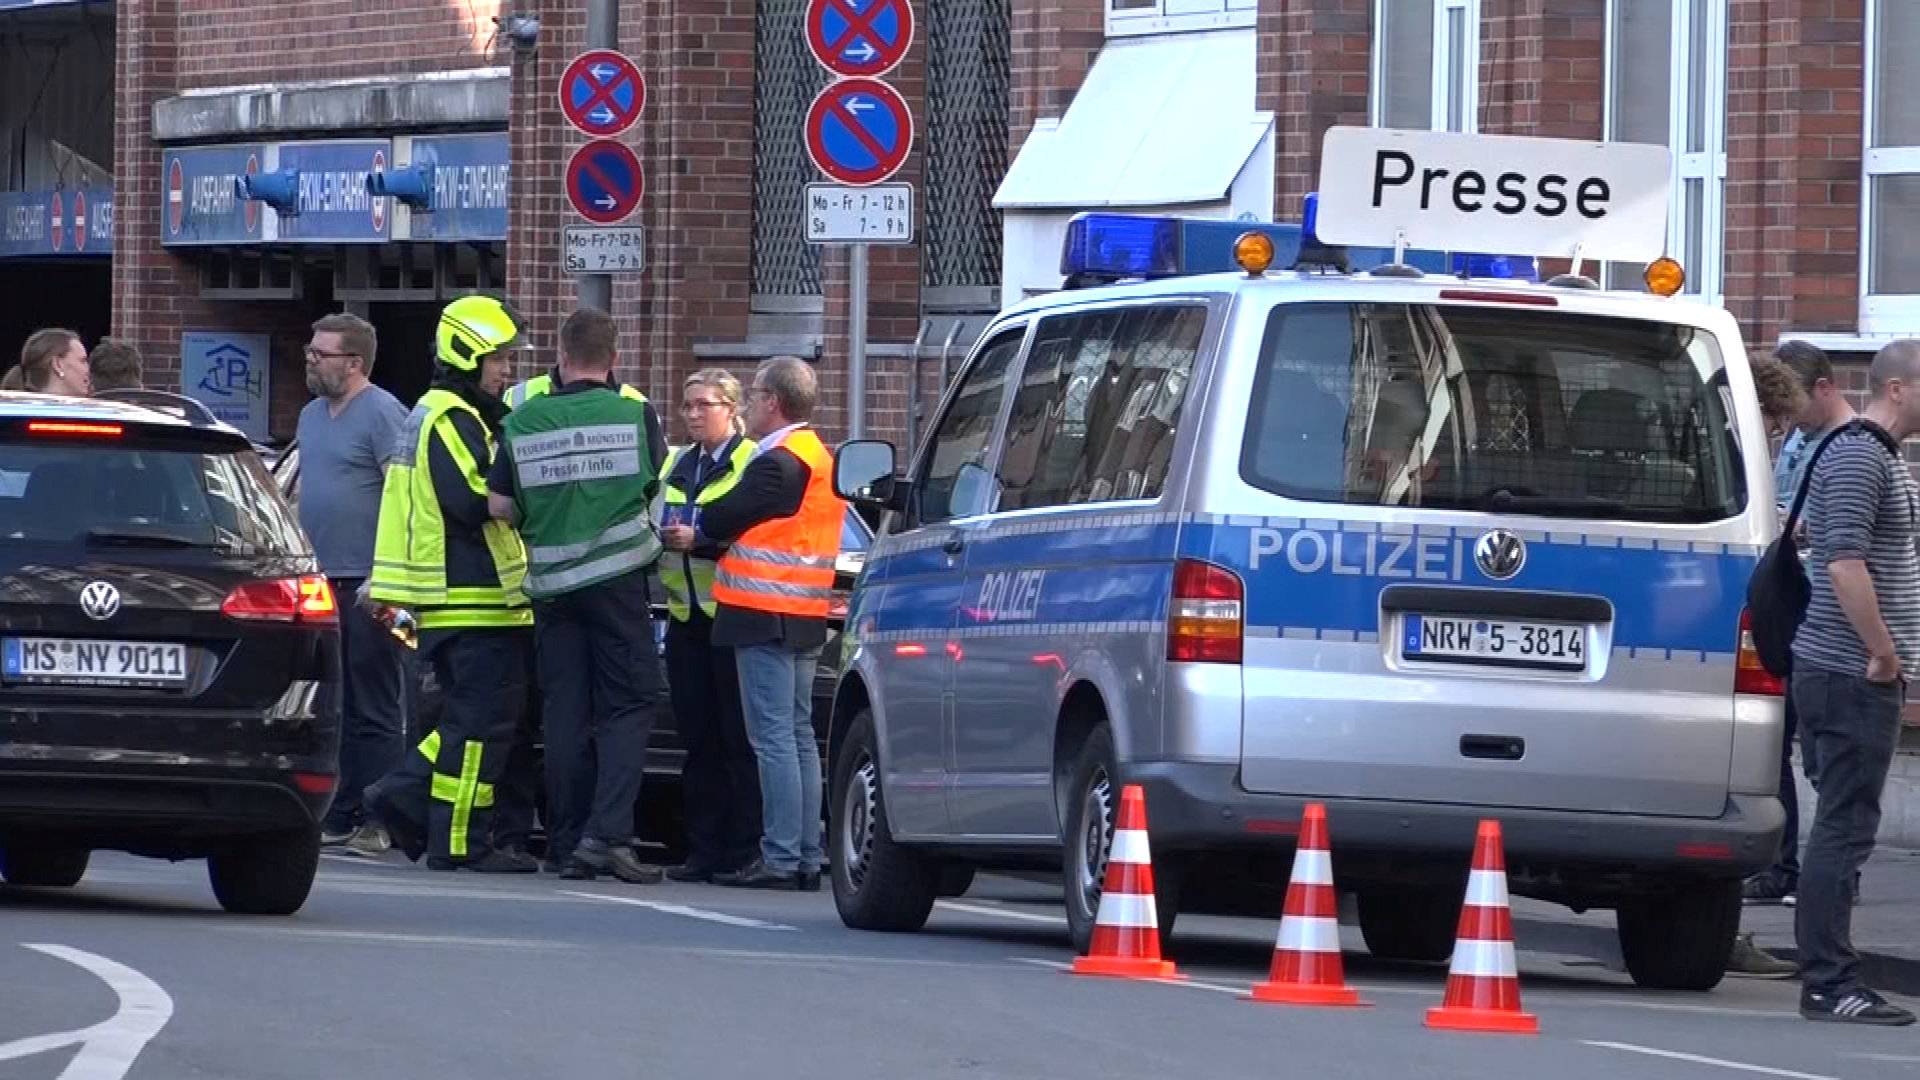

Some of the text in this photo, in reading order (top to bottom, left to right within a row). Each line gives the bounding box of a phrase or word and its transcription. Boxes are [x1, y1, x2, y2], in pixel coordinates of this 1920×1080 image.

[191, 175, 237, 214] AUSFAHRT
[299, 171, 370, 211] PKW-EINFAHRT
[434, 164, 510, 208] PKW-EINFAHR
[813, 194, 828, 210] Mo
[843, 194, 853, 210] Fr
[861, 195, 867, 210] 7
[884, 195, 893, 210] 12
[898, 195, 904, 210] h
[1372, 149, 1611, 219] Presse
[813, 217, 826, 233] Sa
[861, 218, 866, 233] 7
[887, 218, 893, 233] 9
[898, 218, 904, 233] h
[567, 254, 586, 268] Sa
[516, 437, 571, 457] FEUERWEHR
[1249, 527, 1463, 581] POLIZEI
[977, 569, 1046, 622] POLIZEI
[23, 641, 56, 671] MS
[77, 643, 110, 673] NY
[118, 645, 182, 675] 9011
[1422, 620, 1472, 650] NRW
[1490, 625, 1582, 658] 5-3814
